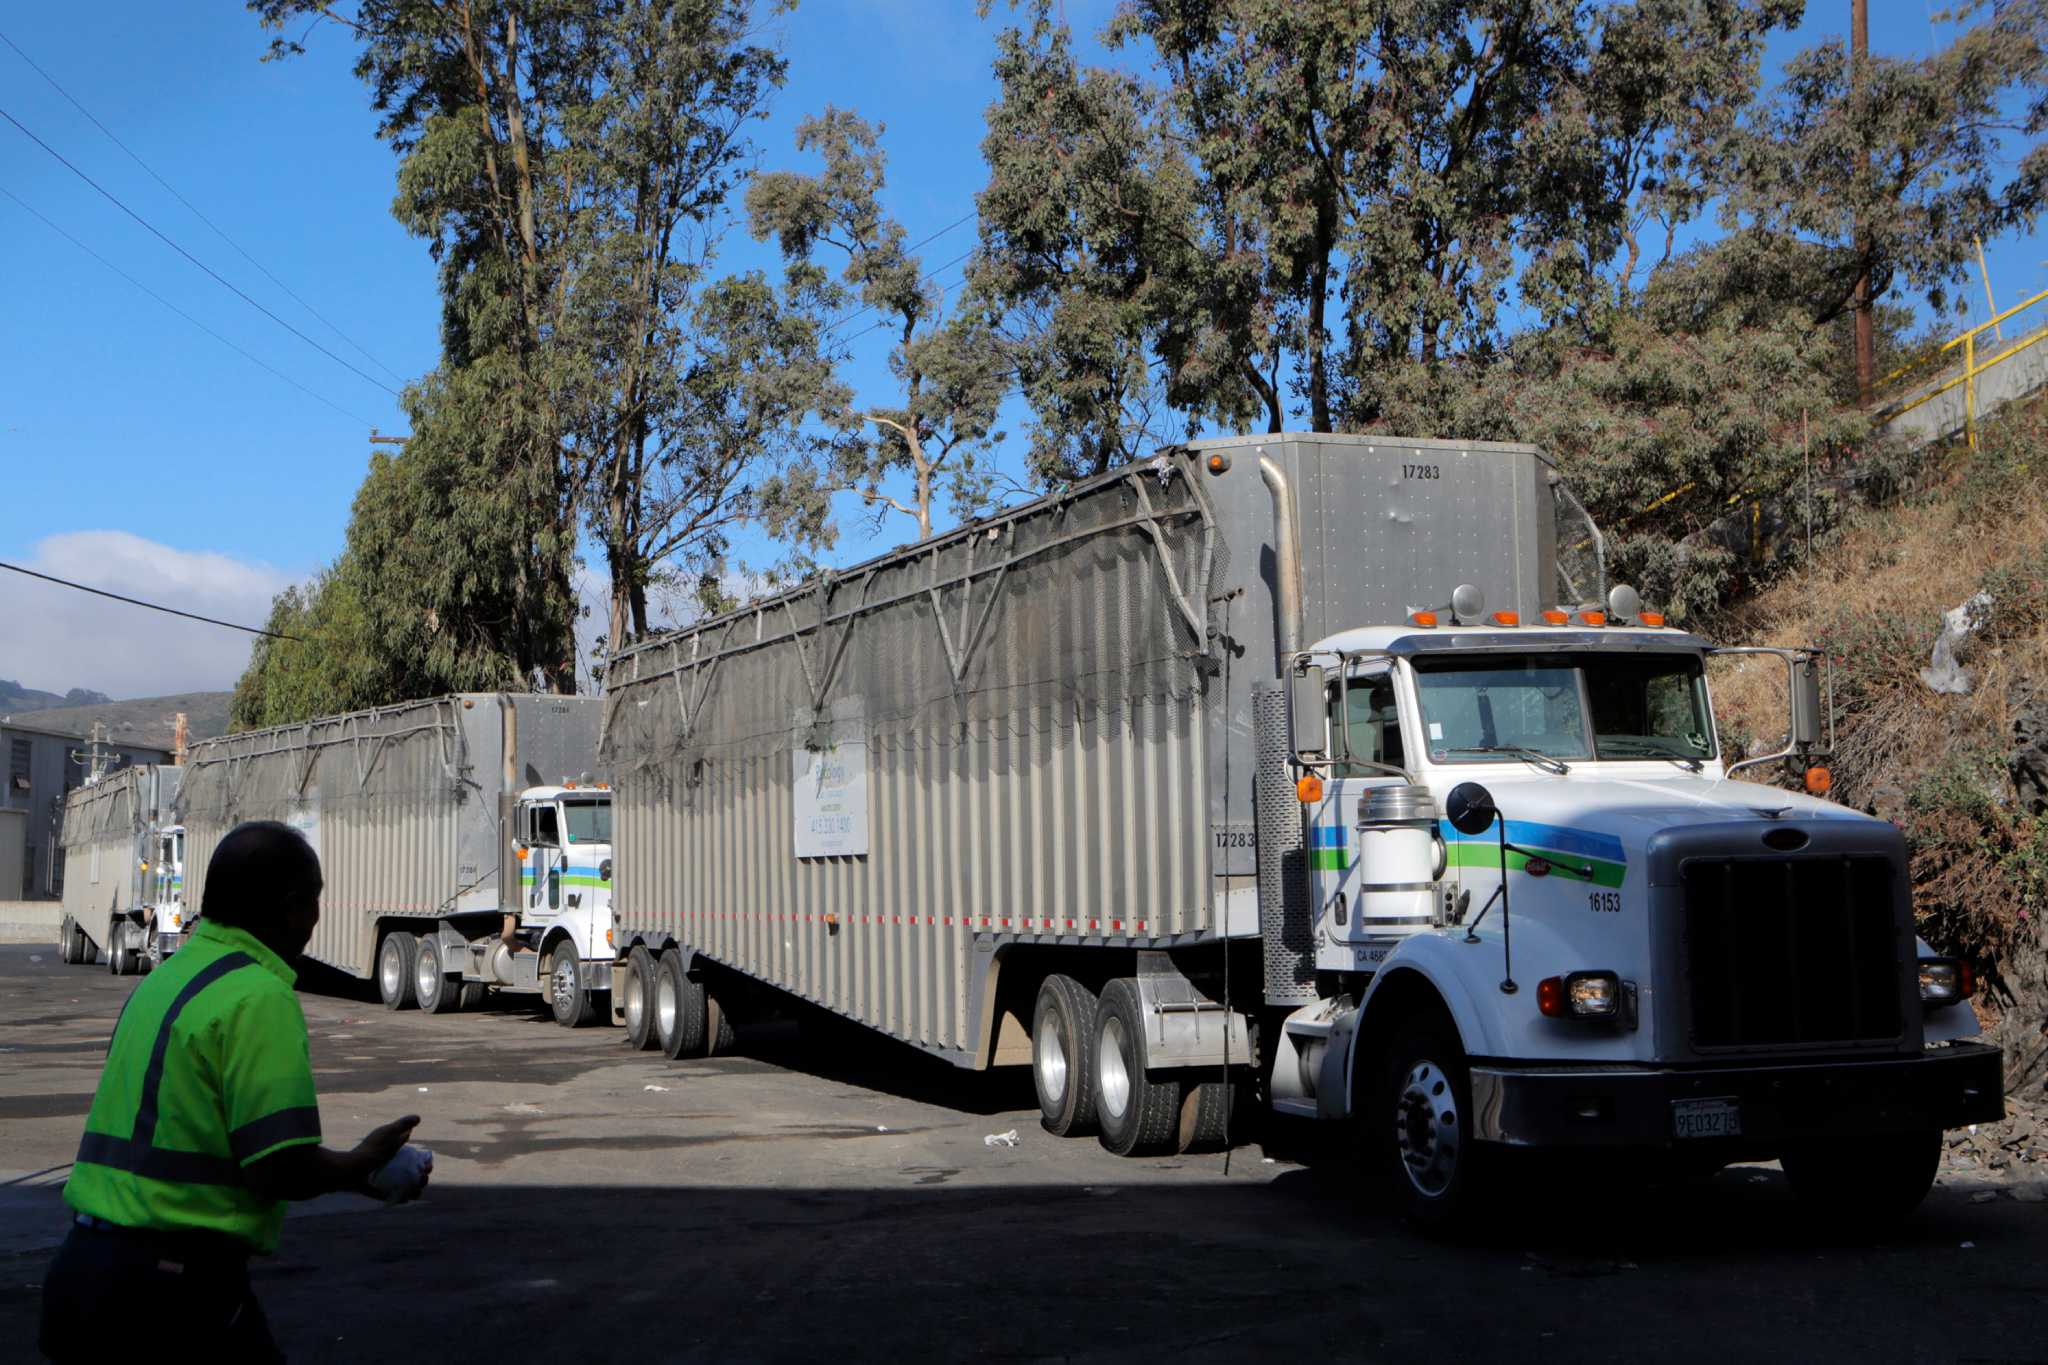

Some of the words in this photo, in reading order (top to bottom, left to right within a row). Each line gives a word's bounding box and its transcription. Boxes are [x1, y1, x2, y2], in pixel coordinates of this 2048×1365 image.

[1402, 464, 1440, 480] 17283
[1216, 832, 1256, 848] 17283
[1588, 891, 1621, 913] 16153
[1357, 949, 1368, 961] CA
